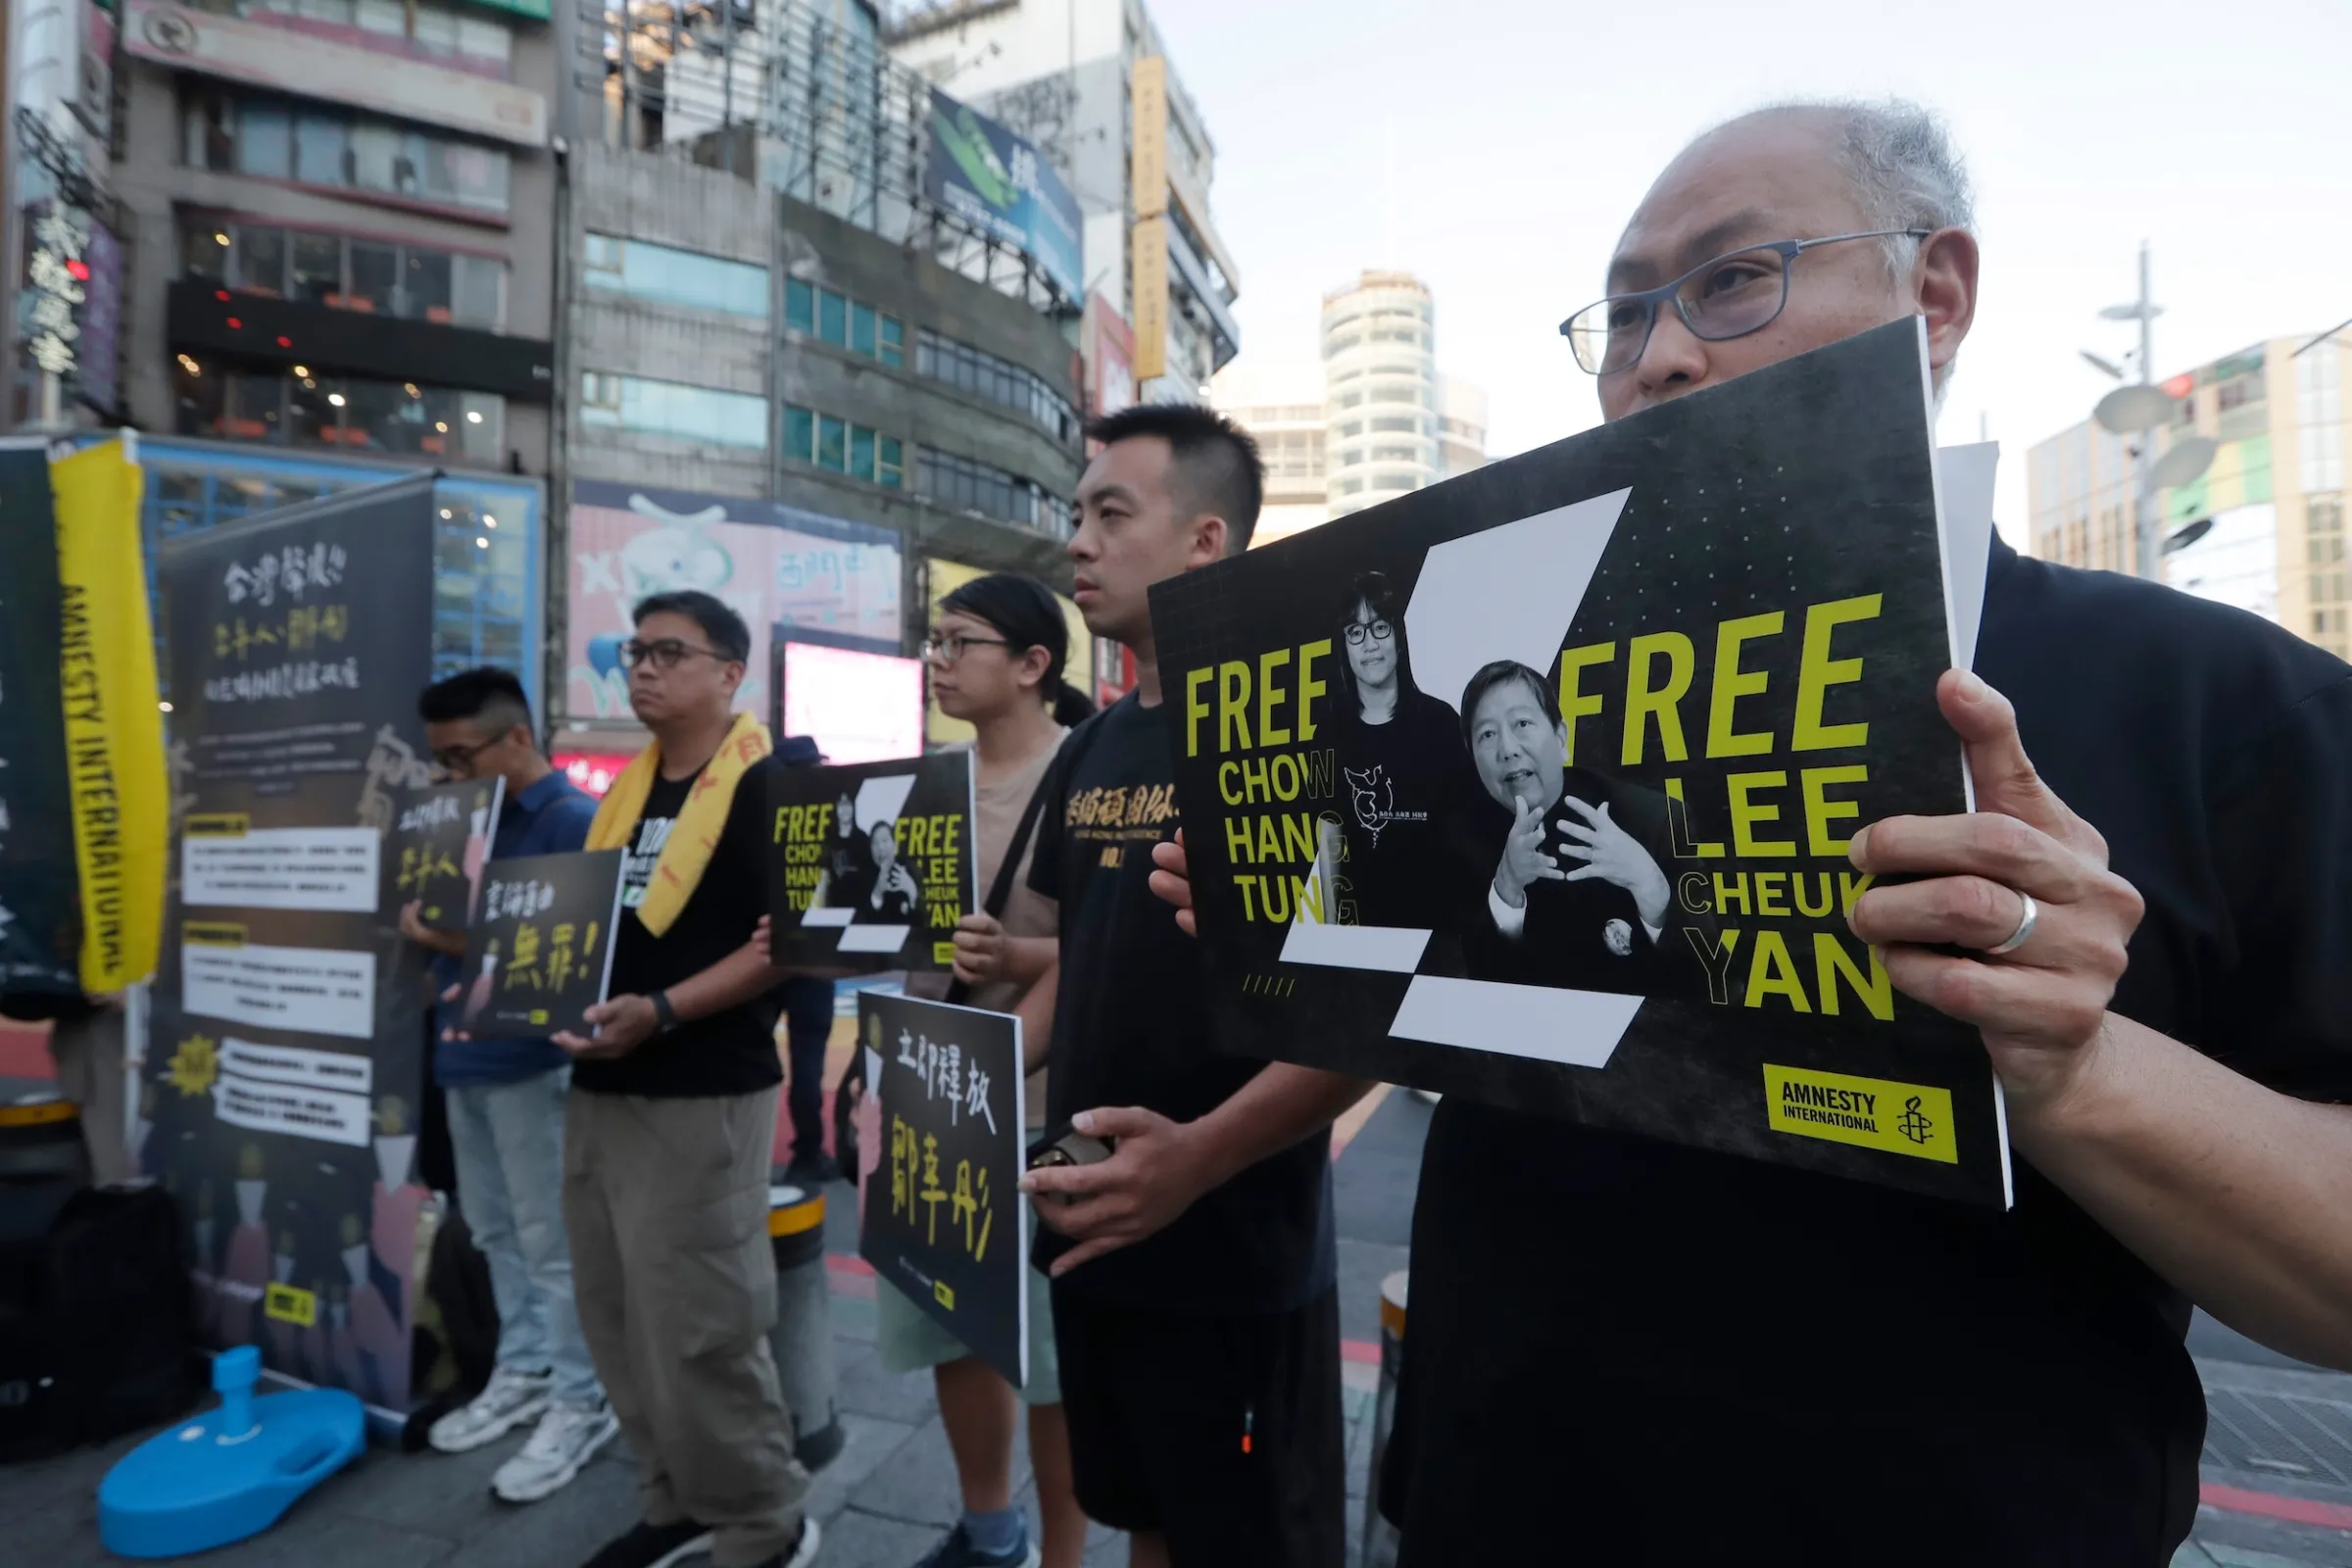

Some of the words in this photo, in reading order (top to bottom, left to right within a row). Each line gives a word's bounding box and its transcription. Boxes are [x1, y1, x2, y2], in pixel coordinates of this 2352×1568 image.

[1187, 638, 1332, 757] FREE
[1558, 592, 1883, 767] FREE
[1219, 749, 1335, 805] CHOW
[1665, 764, 1869, 859] LEE
[785, 845, 821, 863] CHO
[894, 814, 962, 858] FREE
[1225, 810, 1350, 863] HANG
[786, 866, 821, 886] HAN
[924, 886, 959, 901] HEUK
[1678, 871, 1876, 918] CHEUK
[787, 890, 824, 910] TUN
[926, 904, 960, 928] AN
[1683, 927, 1894, 1021] YAN
[898, 1029, 998, 1135] 立即釋放
[1783, 1081, 1876, 1115] AMNESTY
[1784, 1104, 1879, 1133] INTERNATIONAL
[892, 1113, 993, 1262] 鄒幸彤
